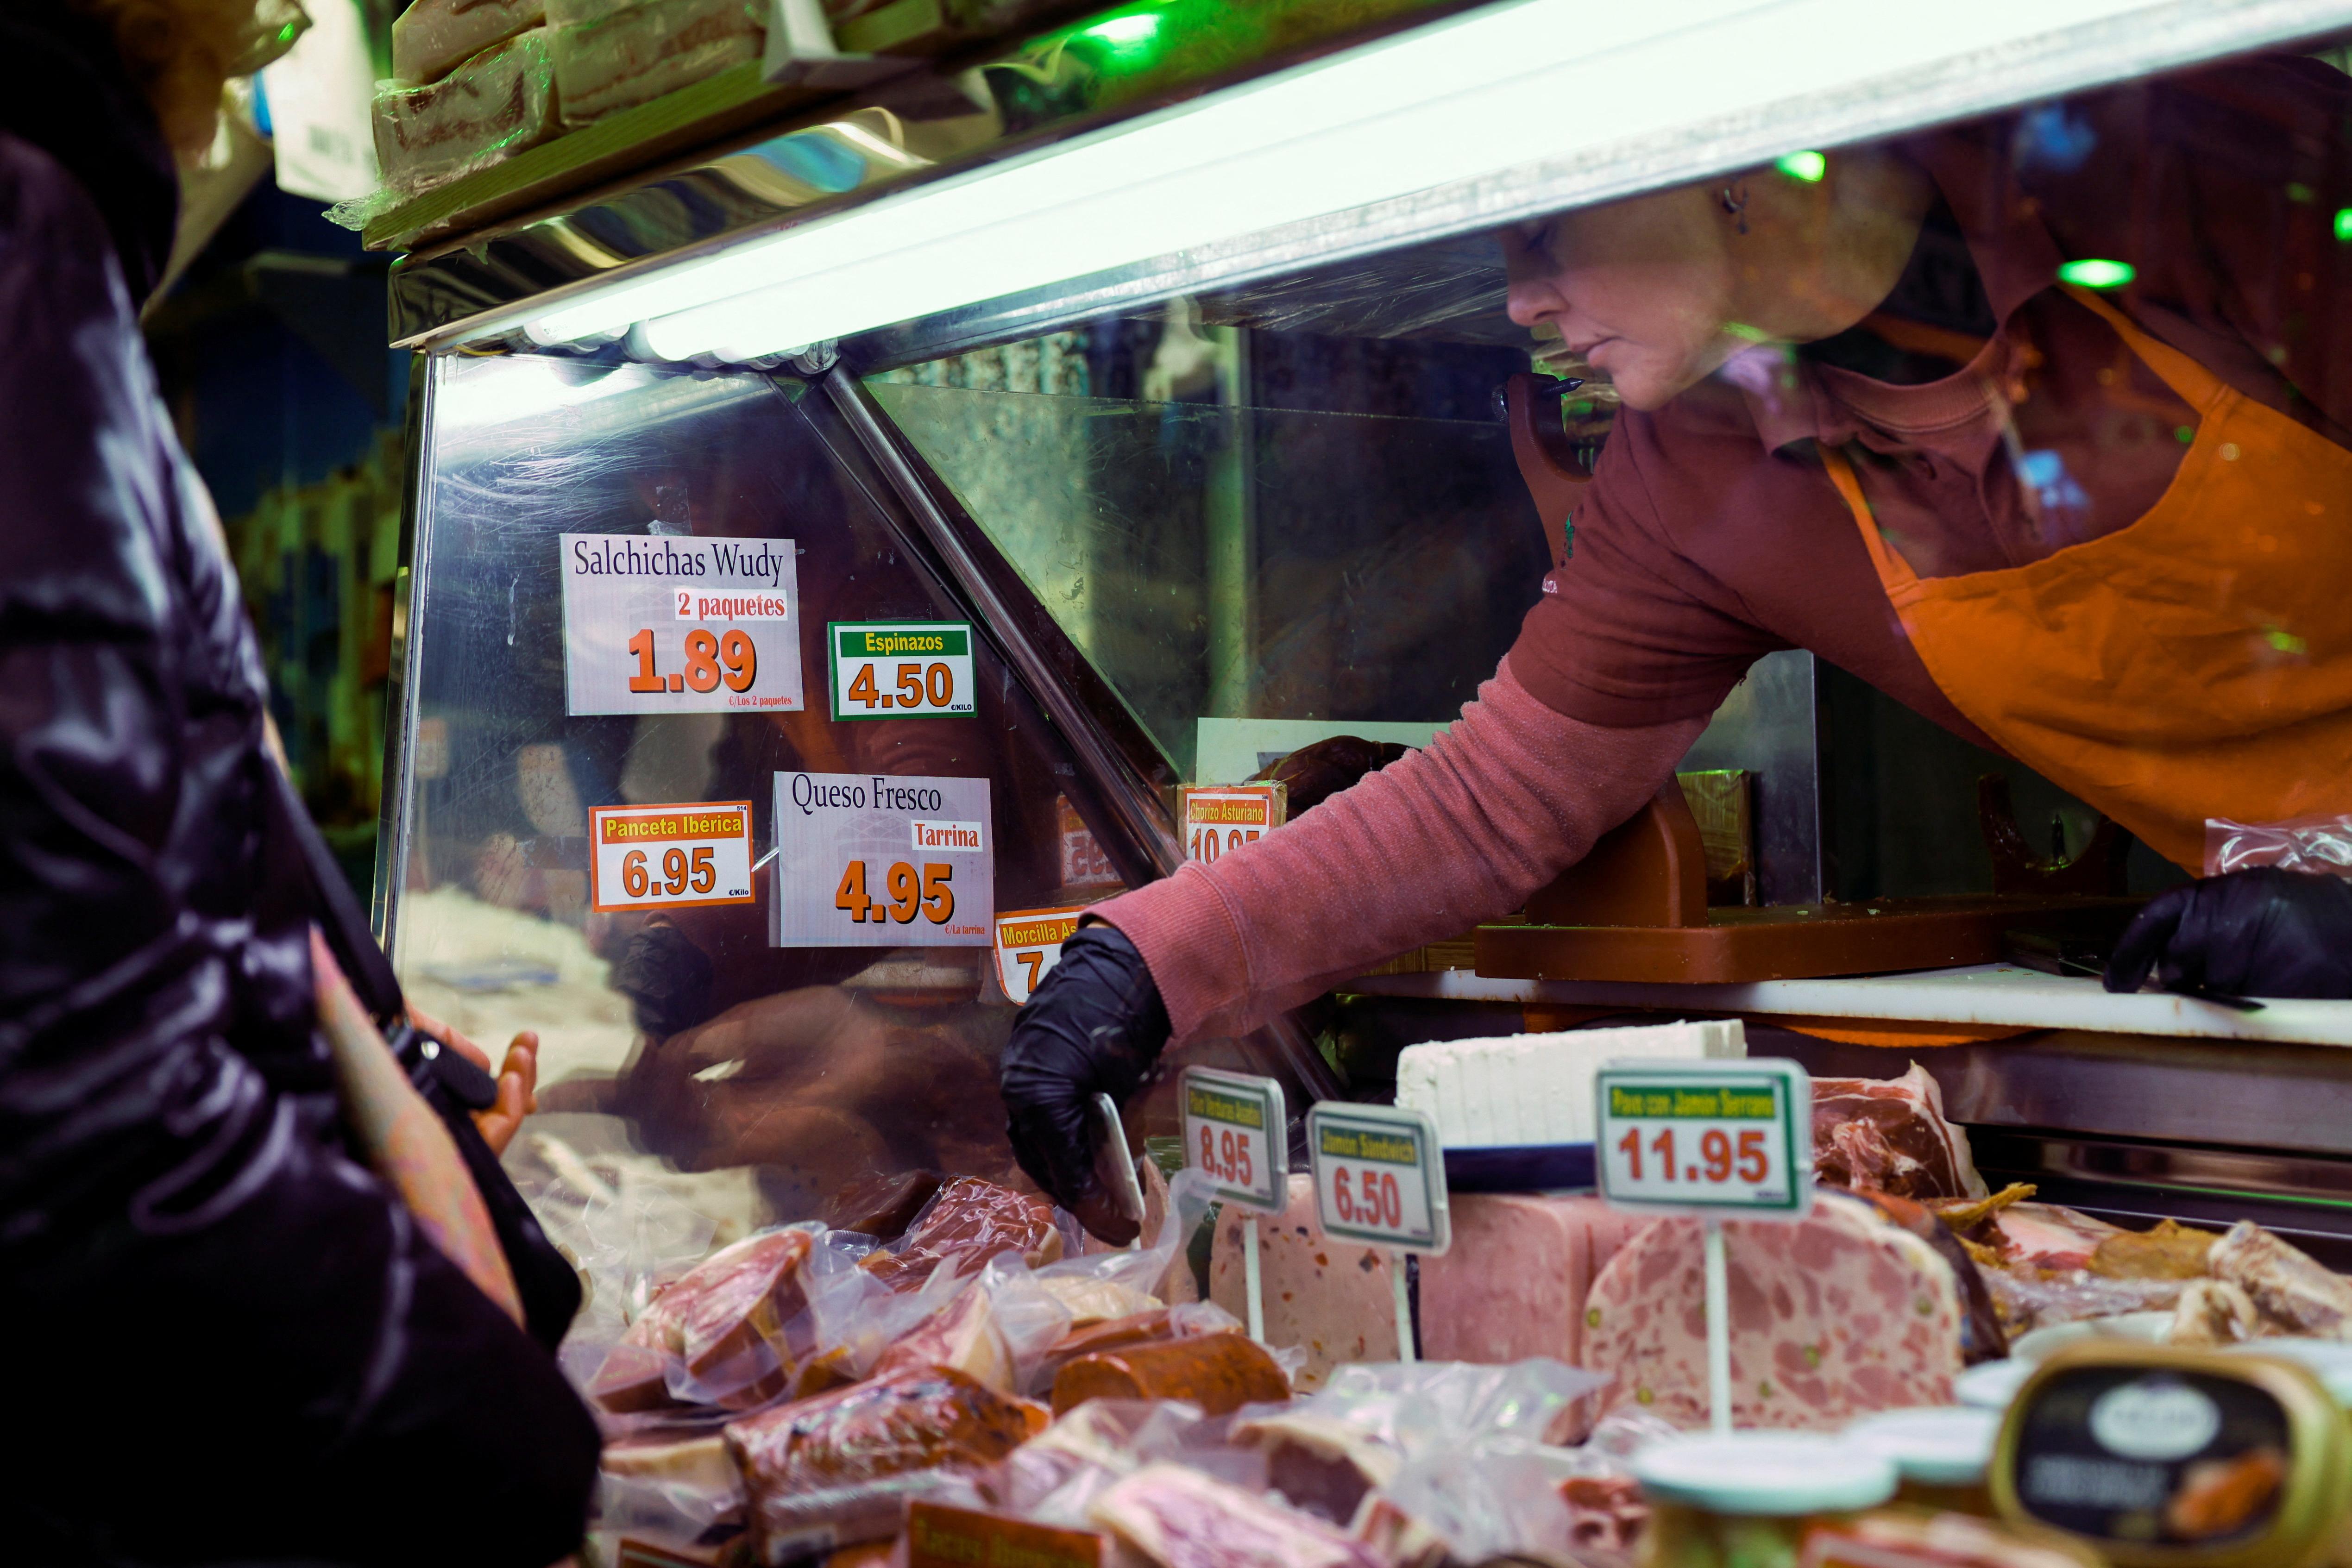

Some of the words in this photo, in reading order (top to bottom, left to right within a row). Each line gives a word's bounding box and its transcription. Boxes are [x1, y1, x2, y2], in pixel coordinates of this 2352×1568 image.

[574, 539, 705, 576] Salchichas
[711, 542, 783, 587] Wudy
[679, 592, 691, 615] 2
[698, 594, 785, 621] paquetes
[629, 629, 757, 693] 1.89
[866, 633, 943, 655] Espinazos
[729, 696, 750, 708] €/Los
[752, 696, 757, 706] 2
[760, 696, 792, 707] paquetes
[849, 662, 953, 708] 4.50
[792, 774, 866, 815] Queso
[872, 778, 941, 811] Fresco
[1190, 802, 1219, 820] Chorizo
[1221, 803, 1264, 822] Asturiano
[606, 818, 677, 837] Panceta
[683, 815, 742, 834] Ibérica
[914, 823, 979, 847] Tarrina
[623, 847, 716, 897] 6.95
[836, 860, 955, 925] 4.95
[945, 925, 960, 936] €/La
[962, 925, 985, 935] tarrina
[1002, 923, 1058, 945] Morcilla
[1200, 1124, 1252, 1186] 8.95
[1618, 1126, 1769, 1184] 11.95
[1334, 1165, 1402, 1229] 6.50
